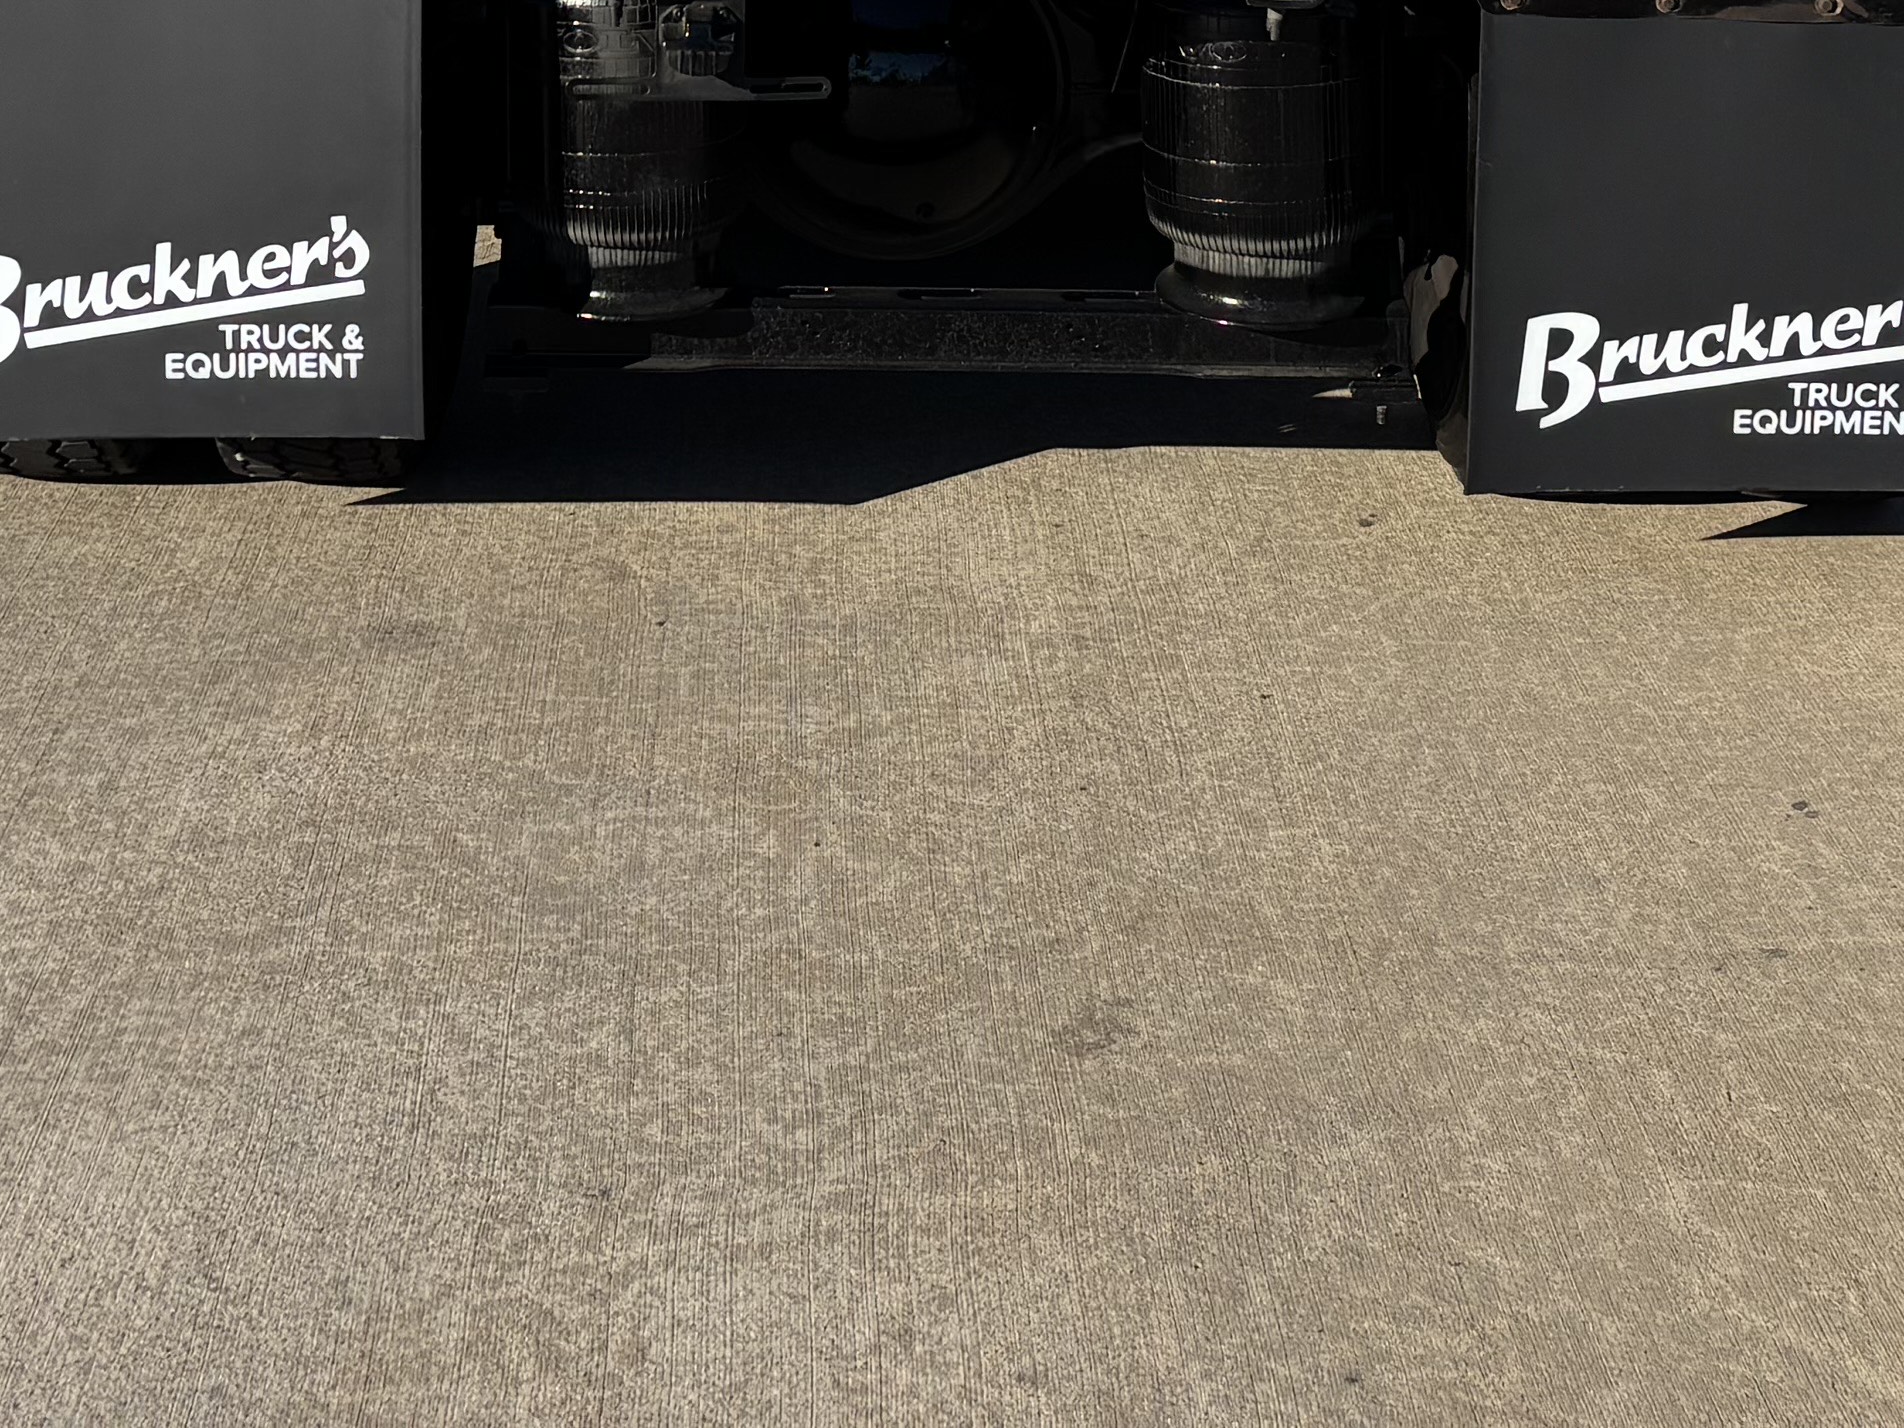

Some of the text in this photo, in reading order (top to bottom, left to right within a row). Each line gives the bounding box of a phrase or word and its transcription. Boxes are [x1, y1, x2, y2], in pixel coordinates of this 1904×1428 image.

[218, 323, 364, 350] TRUCK &
[164, 352, 364, 380] EQUIPMENT
[1788, 382, 1898, 408] TRUCK
